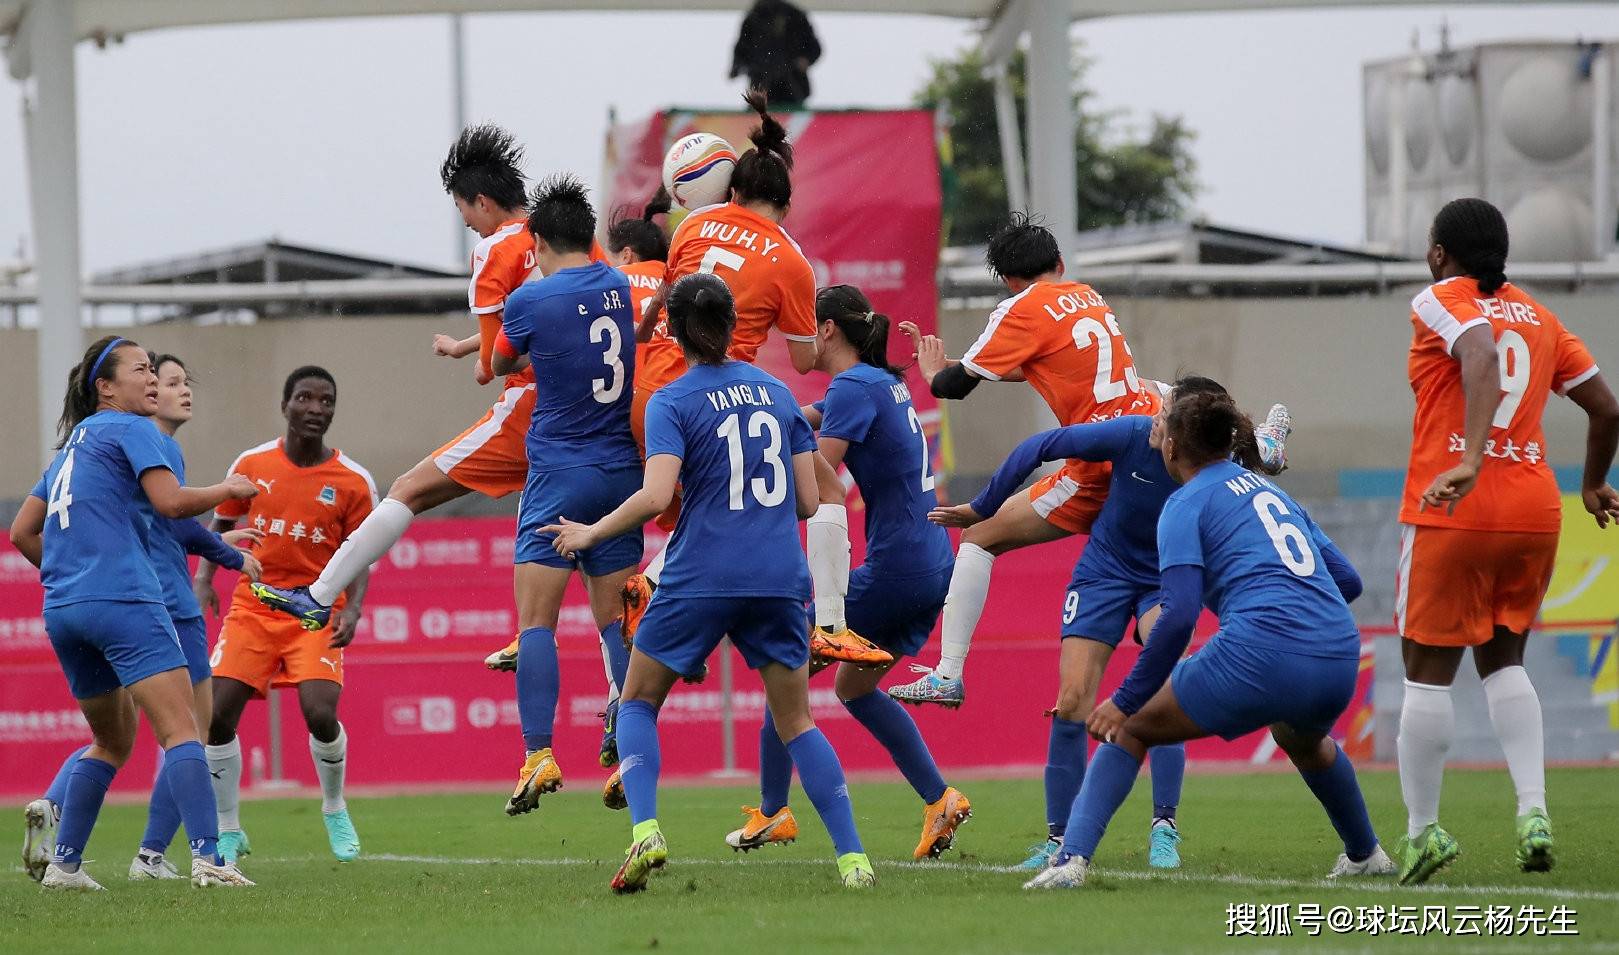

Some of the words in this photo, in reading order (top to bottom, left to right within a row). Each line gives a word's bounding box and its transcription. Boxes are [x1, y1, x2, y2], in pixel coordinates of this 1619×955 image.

[589, 315, 625, 404] 3
[47, 448, 75, 530] 4
[716, 411, 787, 511] 13
[907, 407, 935, 493] 2
[254, 513, 327, 544] 中国丰谷
[1252, 490, 1316, 577] 6
[1062, 590, 1080, 625] 9
